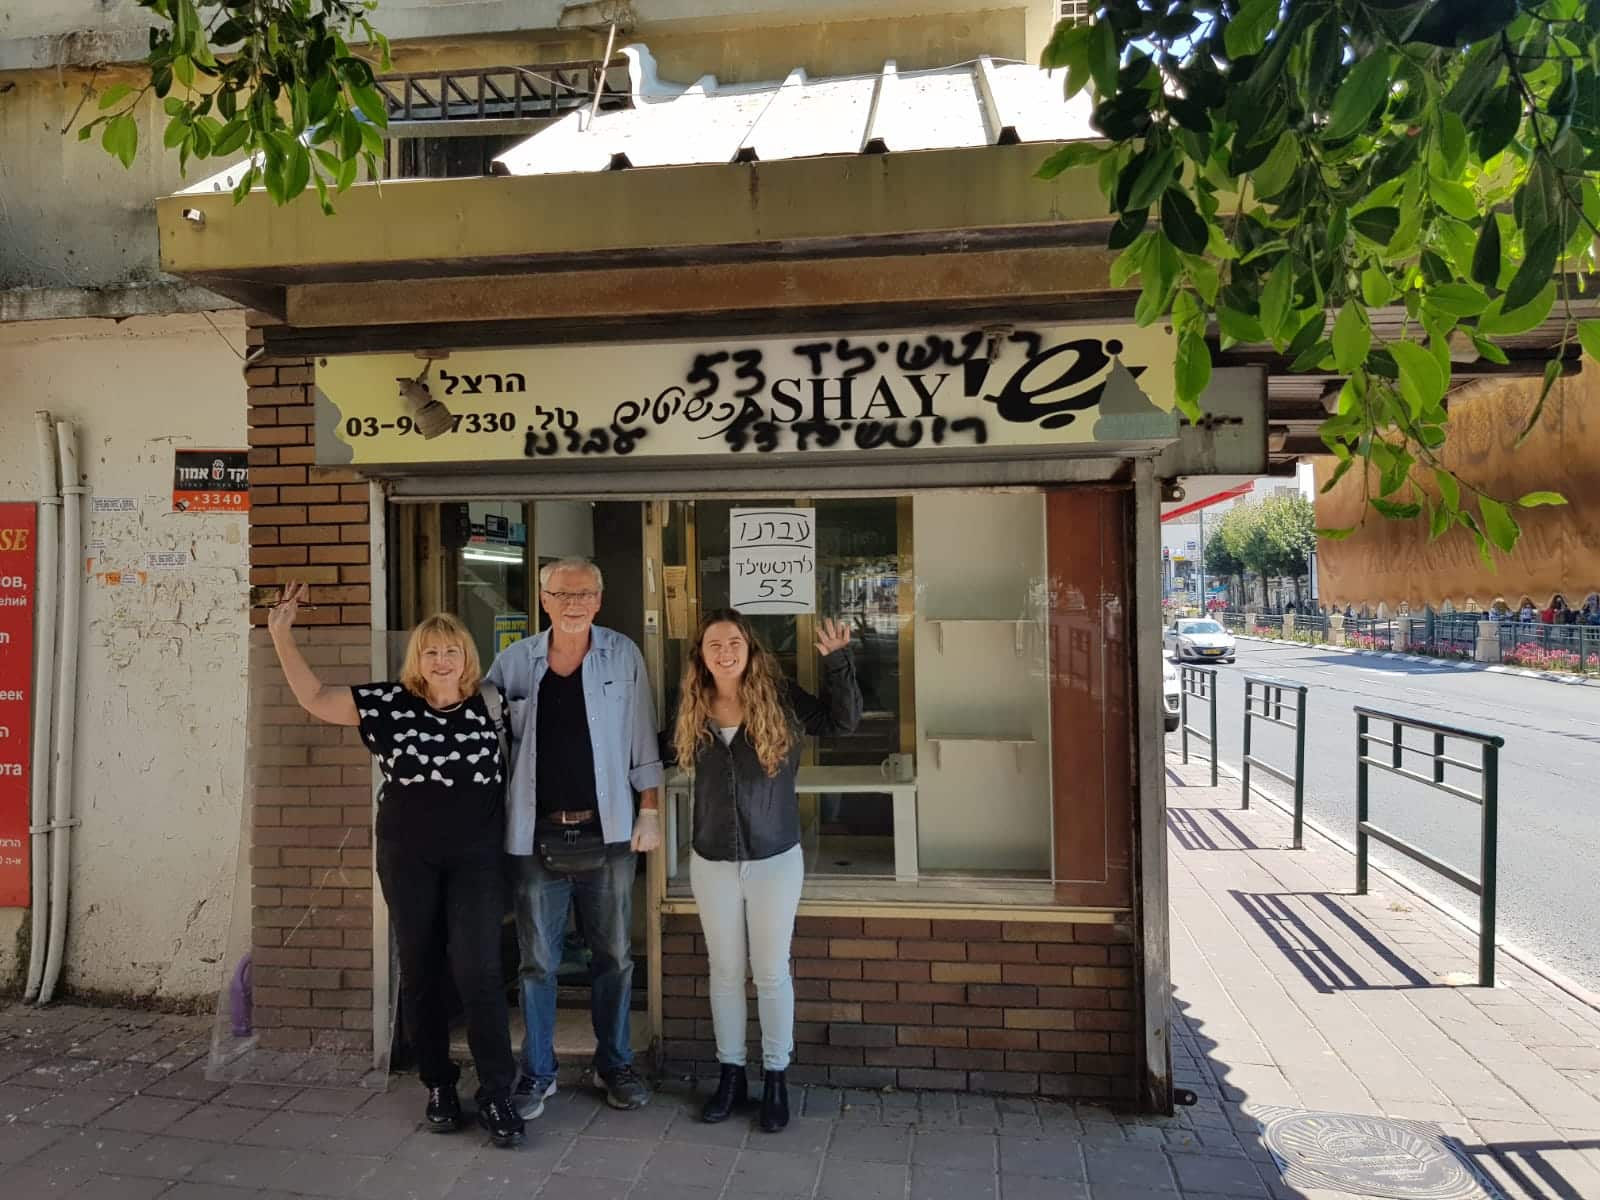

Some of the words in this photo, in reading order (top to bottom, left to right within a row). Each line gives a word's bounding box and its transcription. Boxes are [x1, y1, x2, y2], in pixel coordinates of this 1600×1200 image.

[440, 369, 526, 395] הרצל
[686, 348, 767, 399] 53
[769, 372, 952, 424] SHAY
[345, 411, 517, 437] 03-97330
[527, 404, 579, 431] טל.
[178, 467, 210, 482] אמון
[740, 520, 811, 543] עברנו
[735, 553, 814, 577] לרוטשילד
[757, 579, 794, 598] 53
